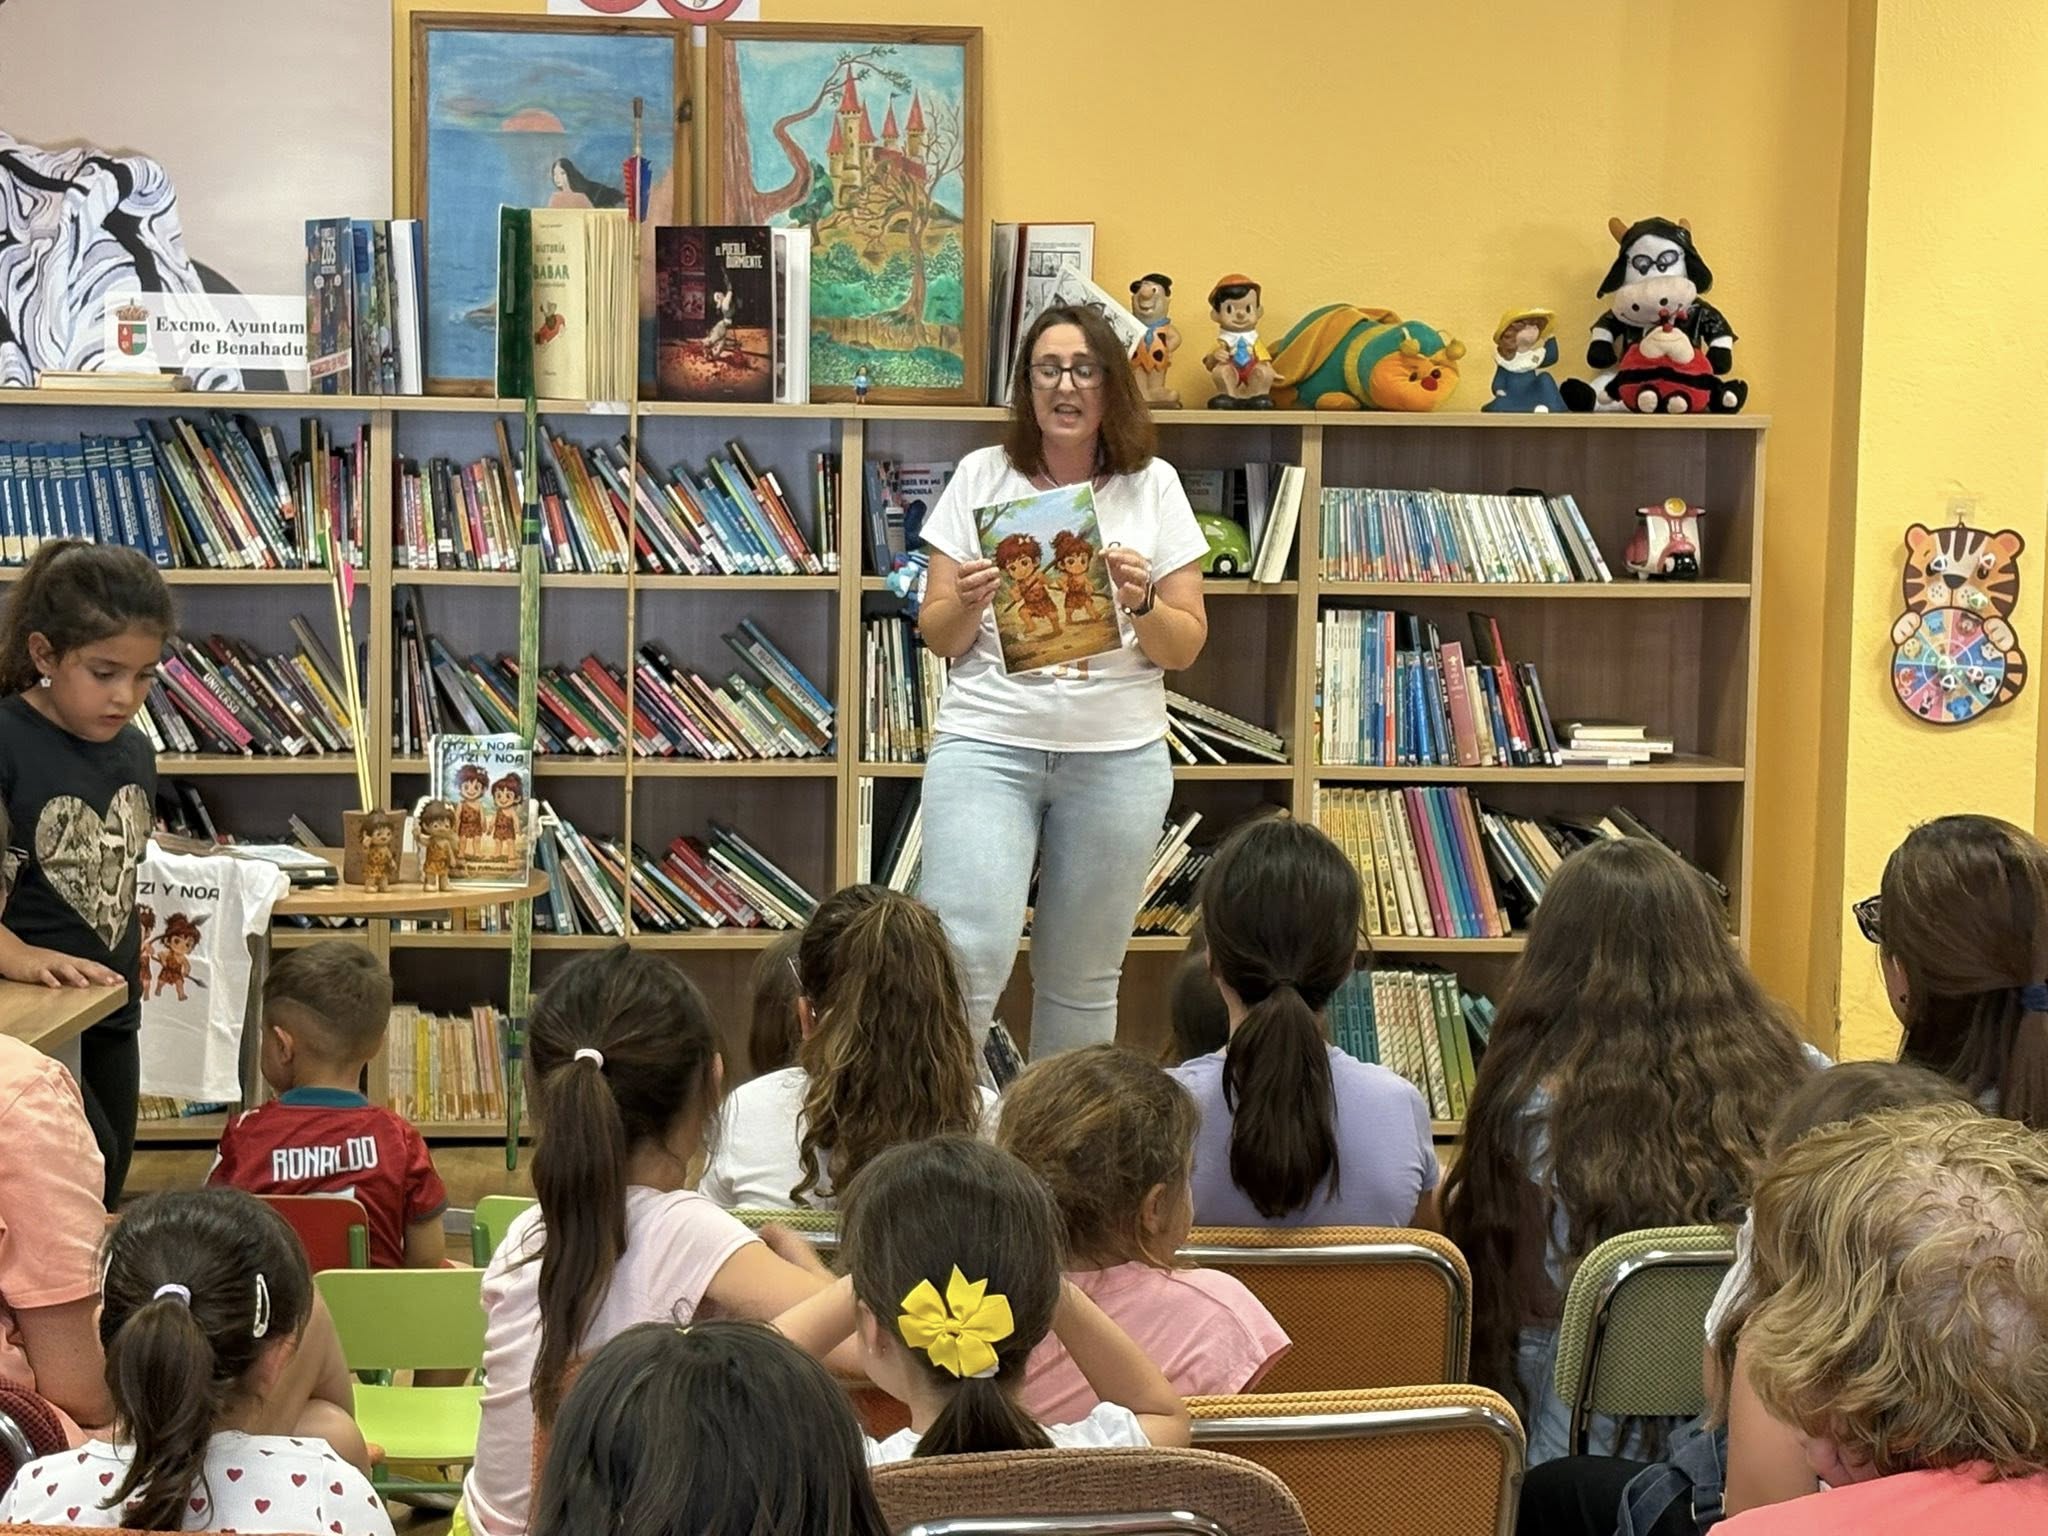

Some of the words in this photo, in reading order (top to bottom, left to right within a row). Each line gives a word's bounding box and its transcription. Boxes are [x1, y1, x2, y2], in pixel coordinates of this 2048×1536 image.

[534, 264, 570, 280] BABAR
[156, 316, 220, 332] Excmo.
[225, 319, 305, 337] Ayuntam
[189, 341, 210, 354] de
[216, 340, 305, 356] Benahadu
[203, 672, 240, 715] UNIVERSO
[474, 742, 482, 750] Y
[487, 742, 515, 751] NOA
[482, 753, 491, 763] Y
[496, 754, 524, 764] NOA
[137, 882, 155, 894] ZI
[162, 883, 174, 896] Y
[180, 886, 220, 900] NOA
[272, 1136, 378, 1182] RONALDO
